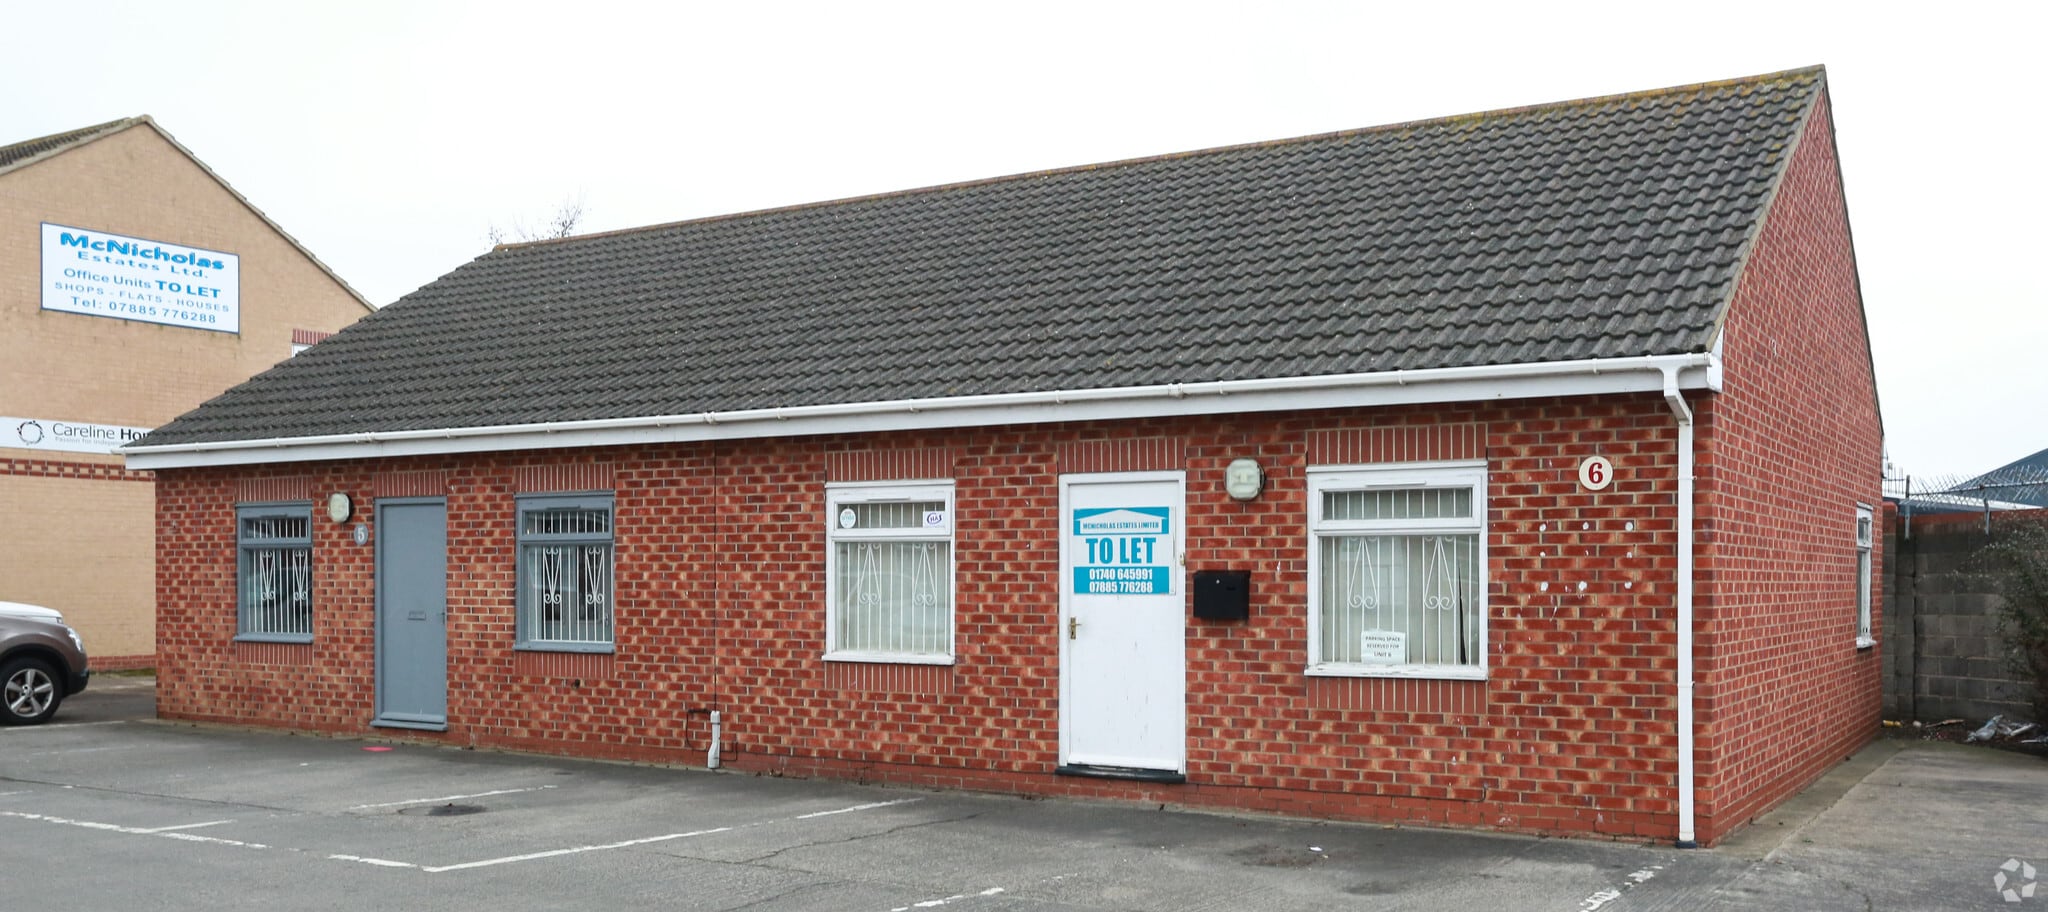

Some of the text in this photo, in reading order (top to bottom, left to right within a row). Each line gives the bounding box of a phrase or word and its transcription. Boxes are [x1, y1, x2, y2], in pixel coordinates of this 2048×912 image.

[60, 231, 225, 270] McNicholas
[77, 250, 208, 279] Estates Ltd.
[63, 267, 222, 299] Office Units TO LET
[54, 281, 105, 296] SHOPS
[119, 290, 163, 304] FLATS
[176, 298, 230, 313] HOUSES
[70, 295, 217, 324] Tel: 07885 776288
[52, 422, 115, 440] Careline
[1588, 462, 1604, 484] 6
[357, 527, 365, 542] 5
[1138, 521, 1159, 529] LIMITED
[1085, 537, 1157, 564] TO LET
[1089, 568, 1153, 580] 01740 645991
[1089, 581, 1153, 593] 07885 776288
